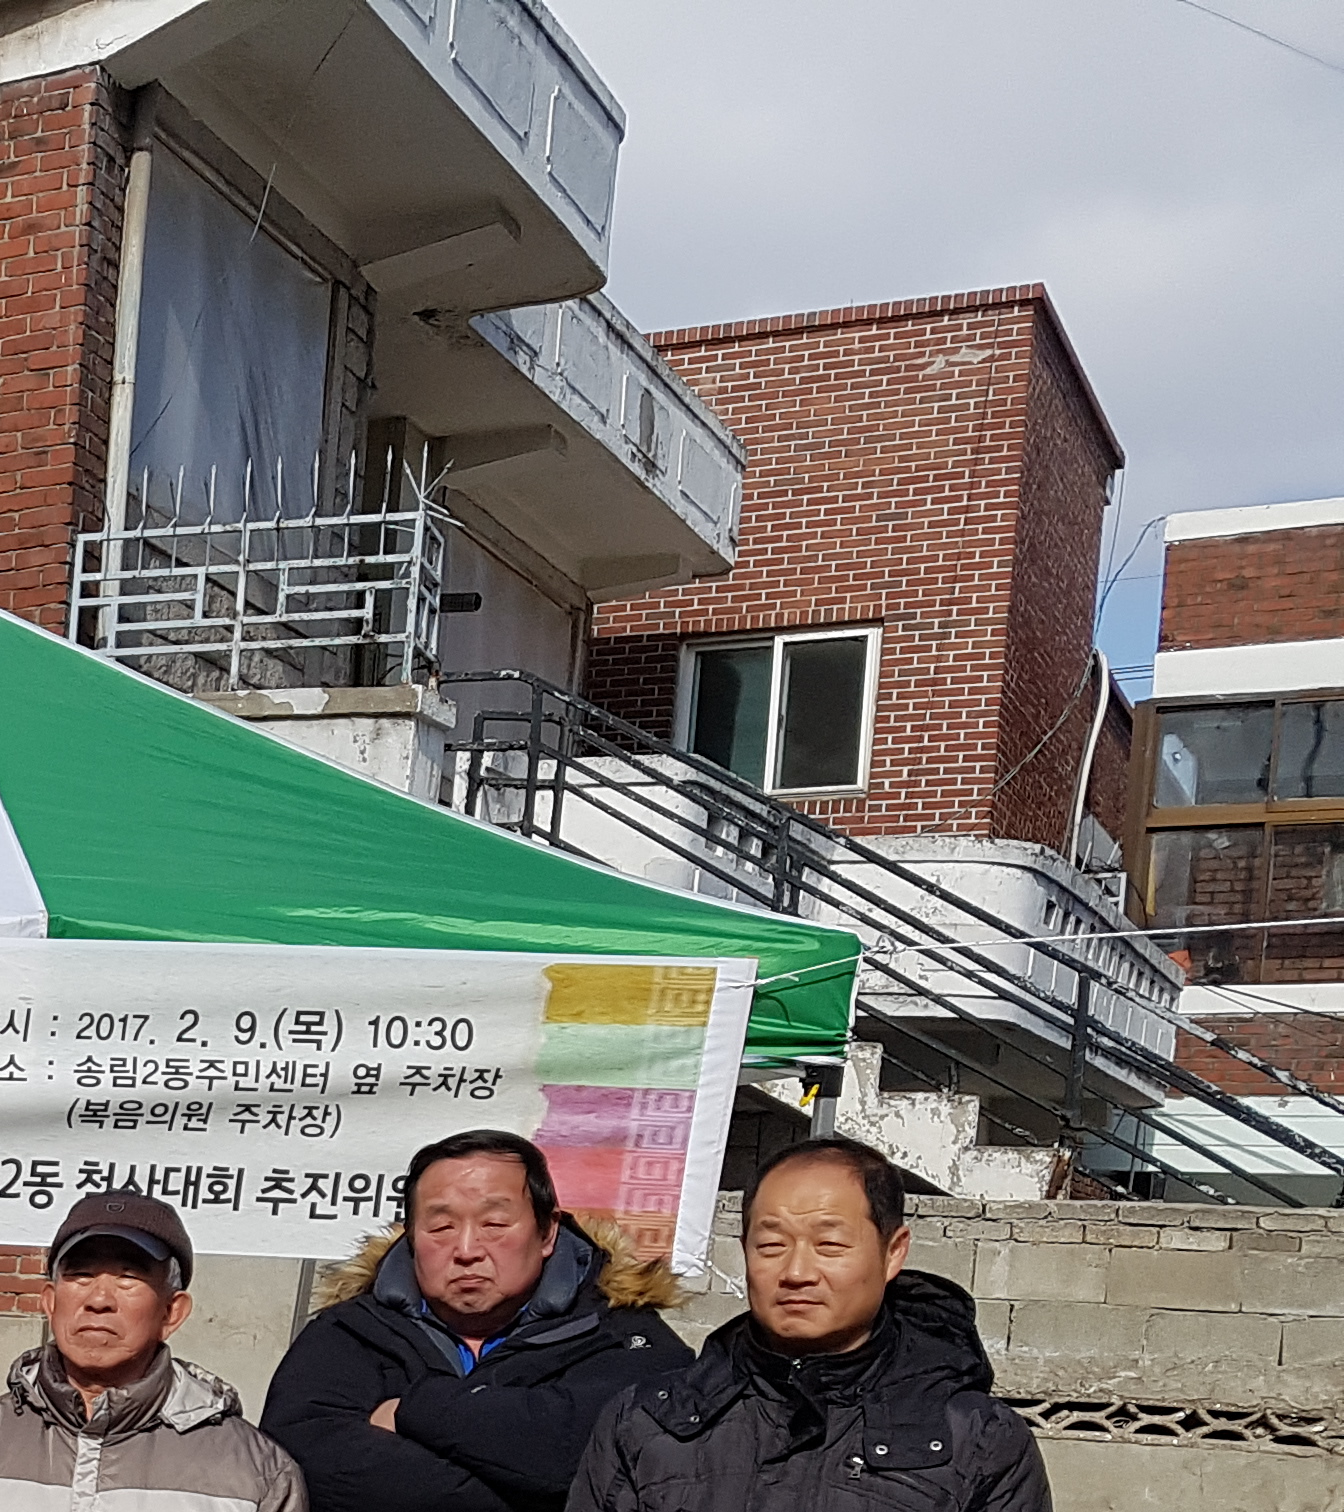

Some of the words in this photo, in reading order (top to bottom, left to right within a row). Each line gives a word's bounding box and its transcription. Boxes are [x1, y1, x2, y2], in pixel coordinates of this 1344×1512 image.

[75, 1012, 156, 1045] 2017.
[367, 1015, 474, 1052] 10:30
[73, 1055, 330, 1095] 송림2동주민센터
[350, 1062, 382, 1096] 옆
[398, 1065, 504, 1100] 주차장
[66, 1097, 214, 1132] (복음의원
[228, 1103, 342, 1139] 주차장)
